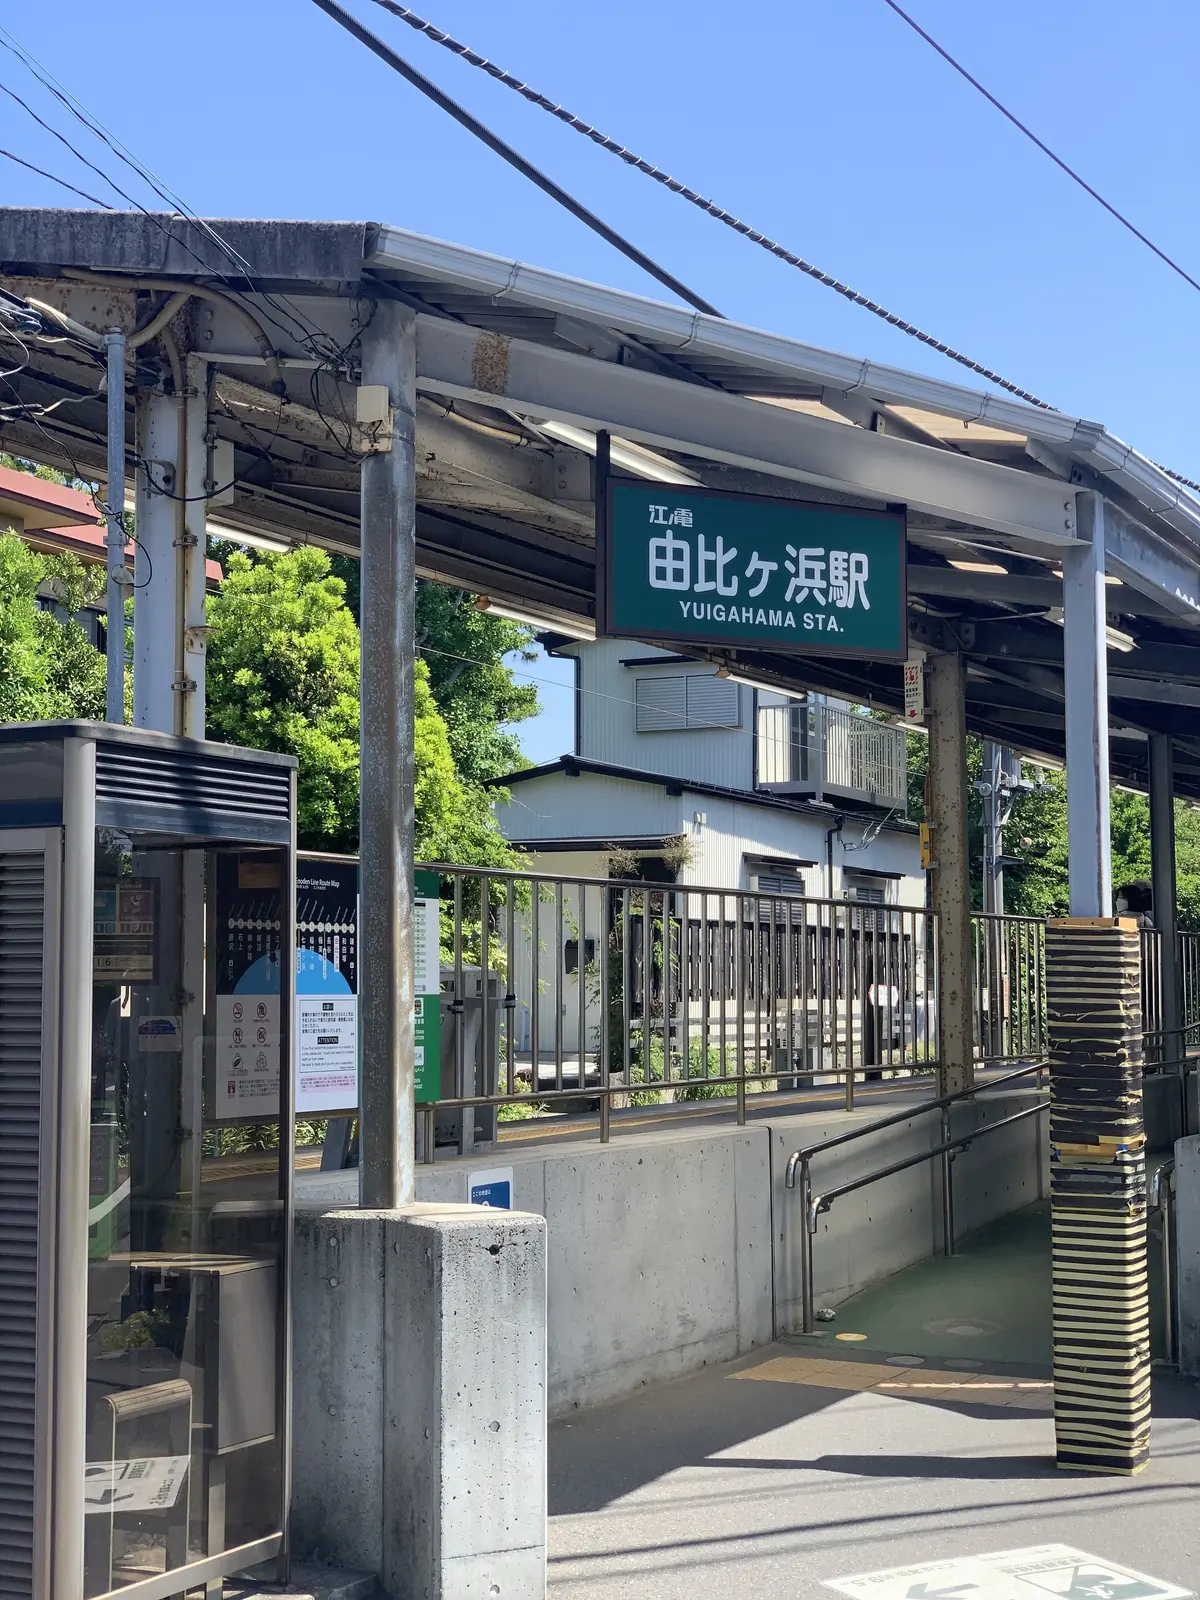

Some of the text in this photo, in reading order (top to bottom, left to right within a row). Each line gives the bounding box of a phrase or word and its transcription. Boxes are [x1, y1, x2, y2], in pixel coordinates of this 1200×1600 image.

[649, 504, 693, 528] 江ノ電
[648, 529, 871, 611] 由比ヶ浜駅
[679, 601, 845, 633] YUIGAHAMA STA.
[319, 879, 331, 887] Route
[331, 880, 340, 888] Map
